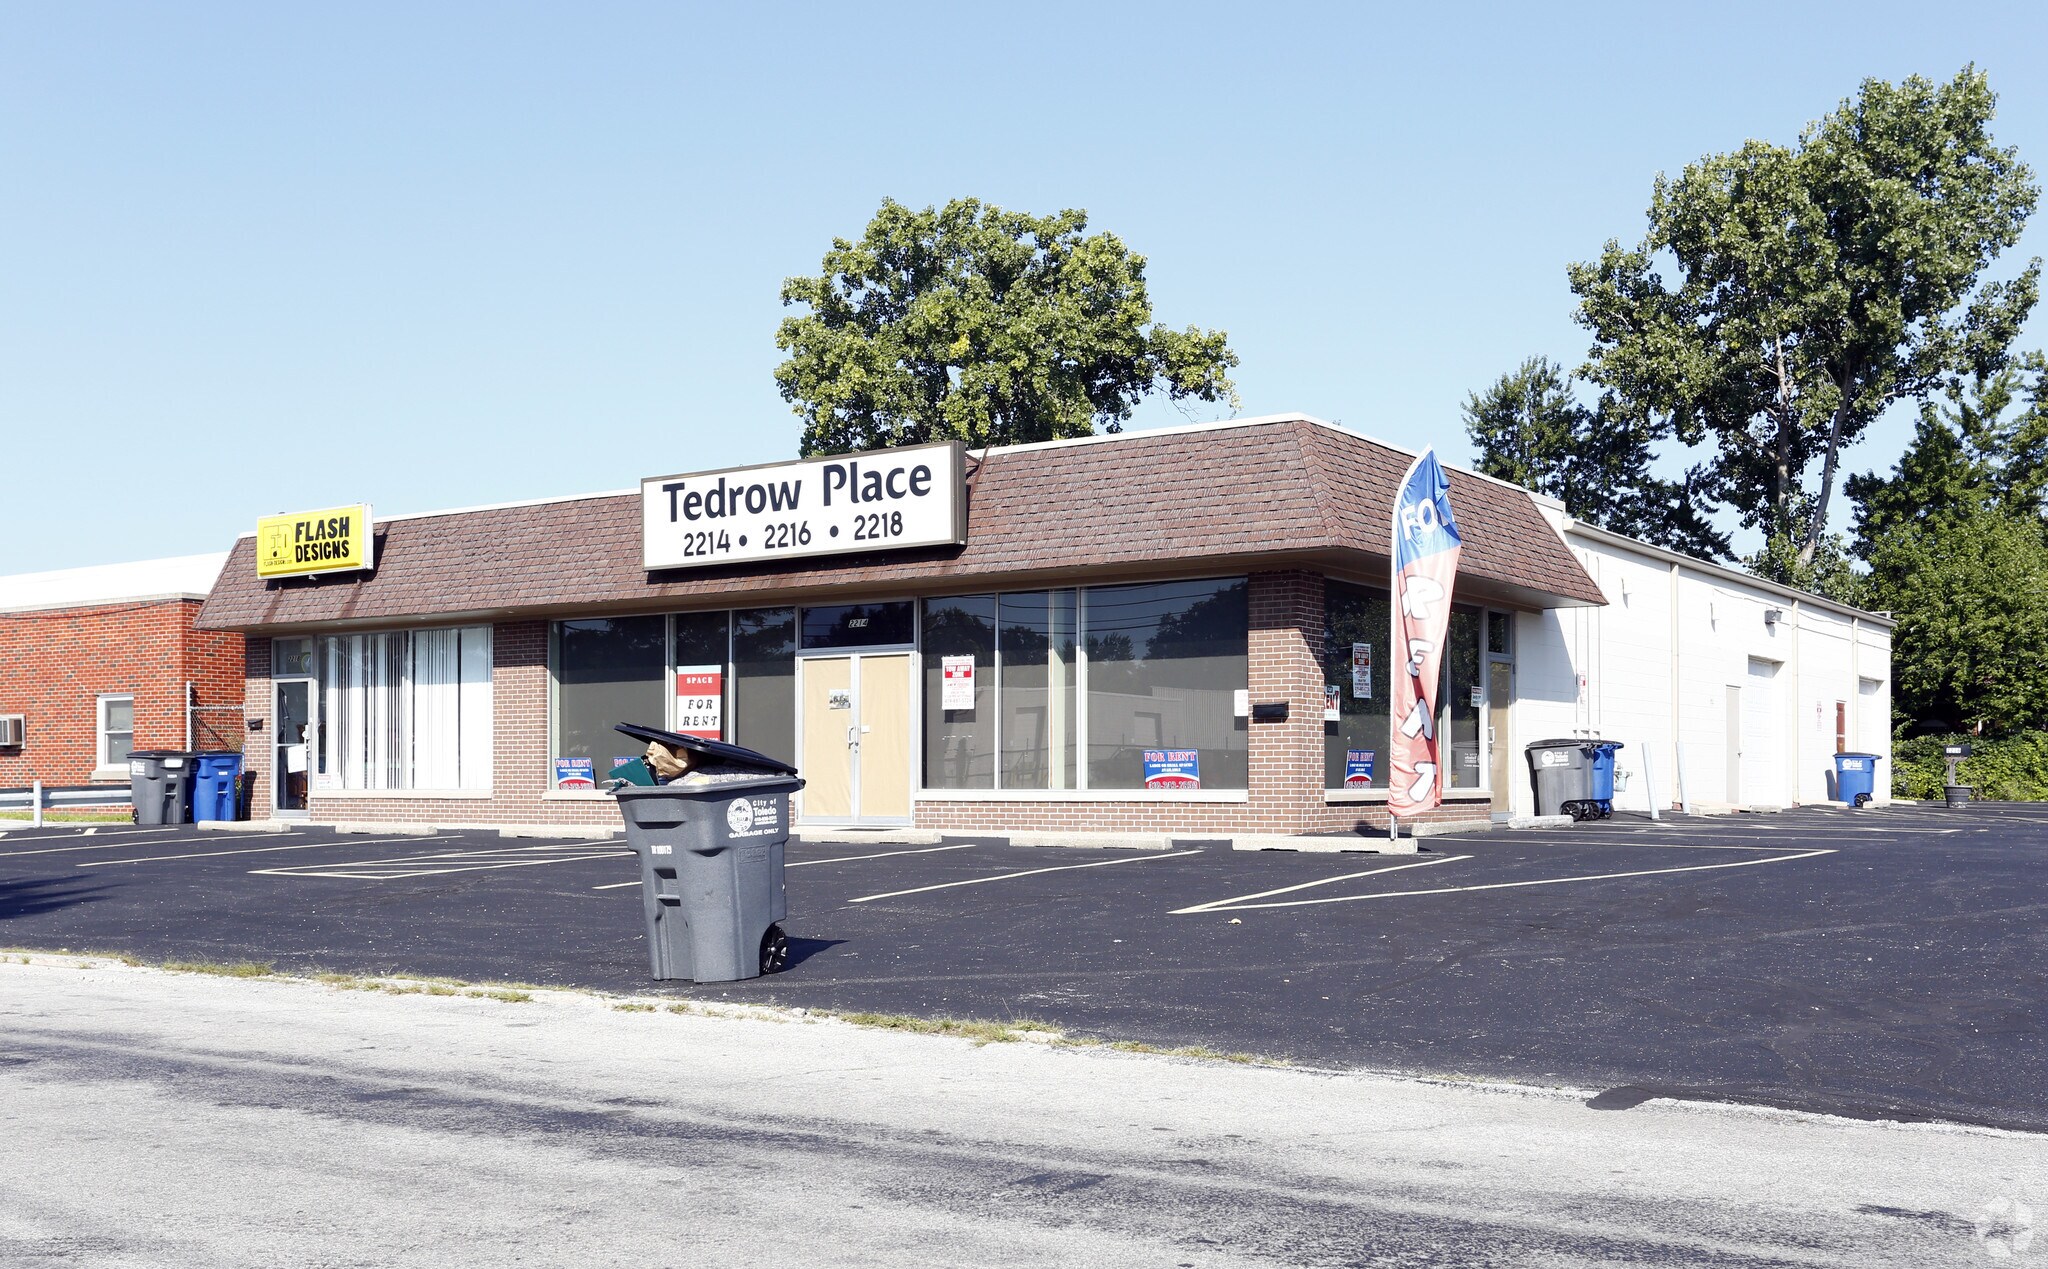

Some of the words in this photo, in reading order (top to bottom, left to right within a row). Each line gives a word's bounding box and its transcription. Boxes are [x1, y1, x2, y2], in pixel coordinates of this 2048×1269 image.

[662, 477, 802, 523] Tedrow
[823, 461, 932, 507] Place
[1401, 498, 1455, 541] FO
[295, 516, 350, 543] FLASH
[683, 529, 730, 557] 2214
[764, 521, 811, 549] 2216
[854, 511, 903, 541] 2218
[295, 540, 350, 563] DESIGNS
[848, 618, 869, 629] 2214
[686, 676, 713, 684] SPACE
[688, 699, 713, 709] FOR
[1324, 690, 1340, 711] ENT
[683, 715, 717, 726] RENT
[1144, 752, 1165, 762] FOR
[1168, 752, 1196, 761] RENT
[753, 806, 777, 816] Toledo
[729, 830, 763, 838] GARBAGE
